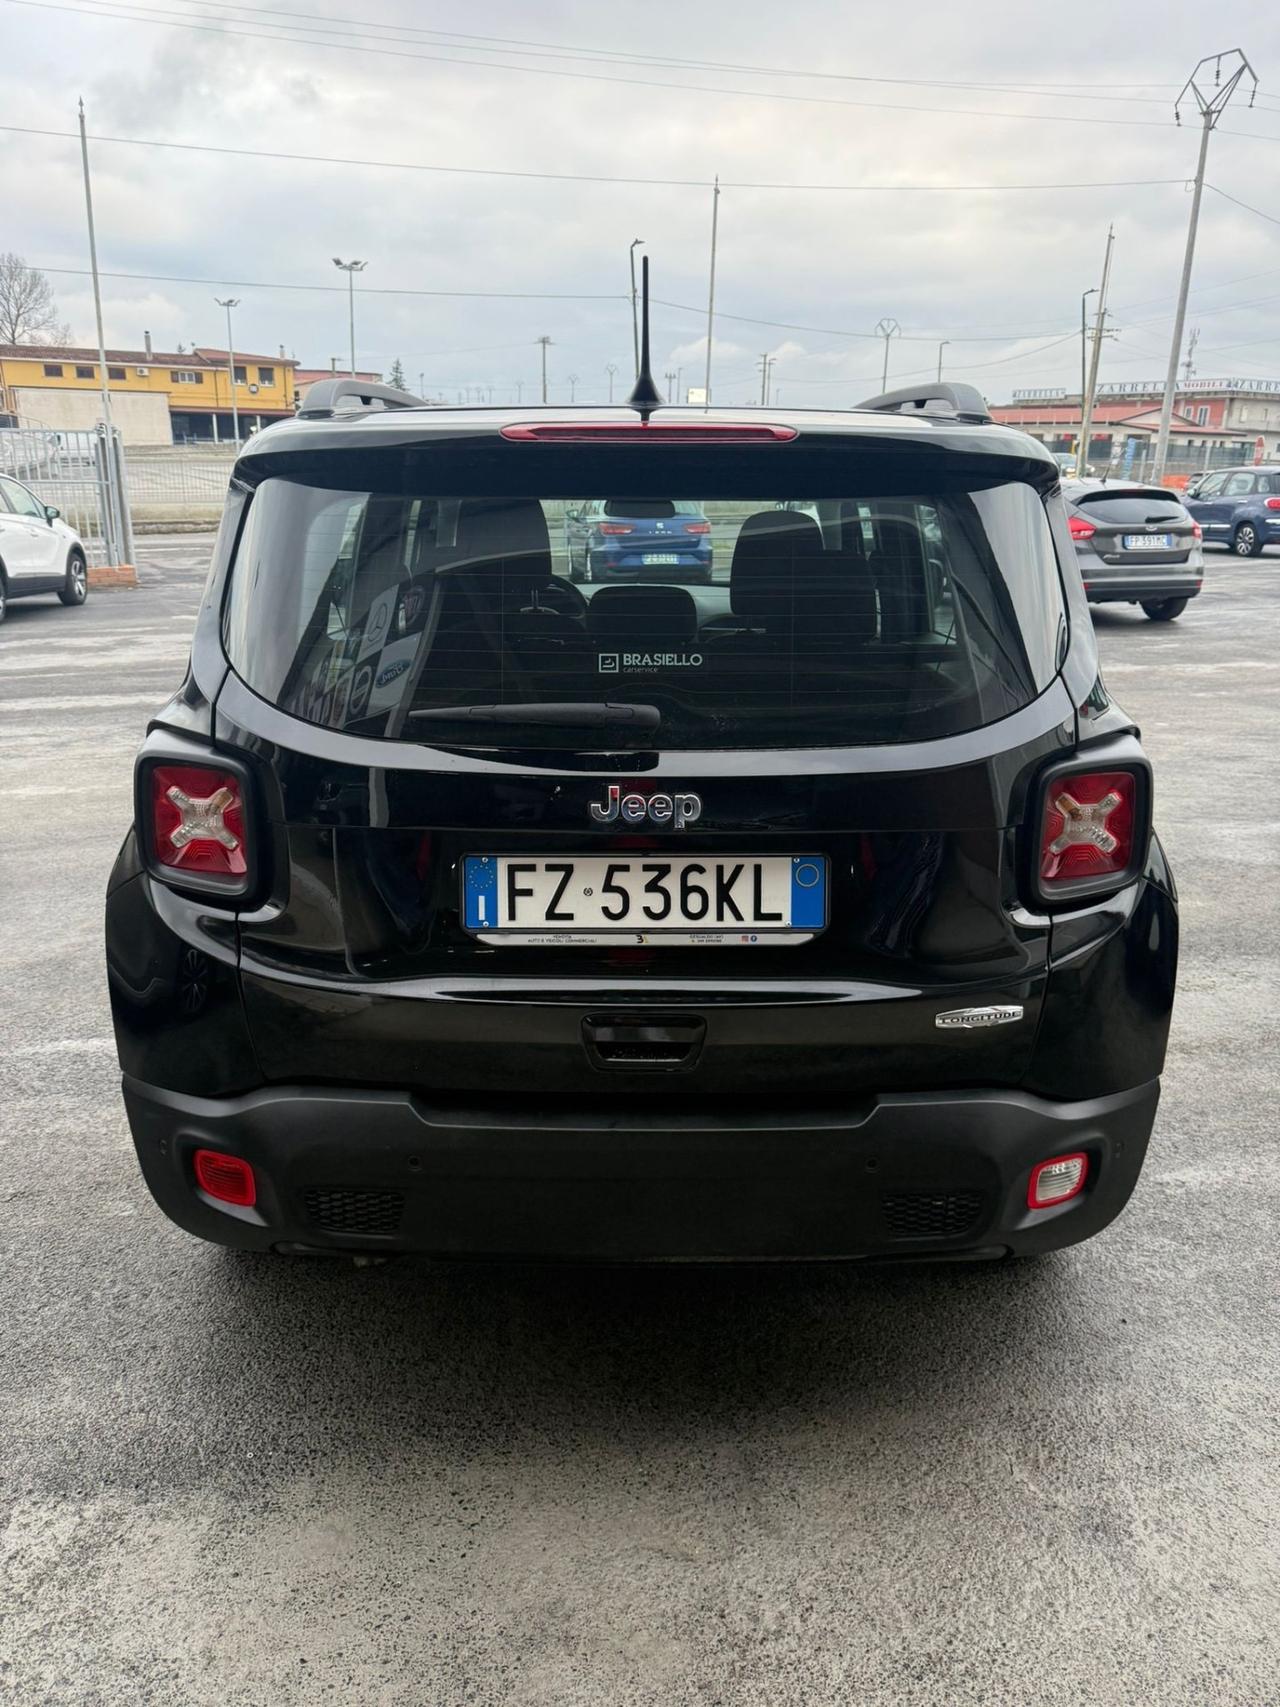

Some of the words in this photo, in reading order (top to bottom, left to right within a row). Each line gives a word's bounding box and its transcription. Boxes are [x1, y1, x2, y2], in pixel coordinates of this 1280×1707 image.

[623, 653, 703, 666] BRASIELLO
[590, 785, 702, 829] Jeep
[507, 863, 574, 921] FZ
[600, 863, 782, 921] 536KL
[941, 1011, 1018, 1024] LONGITUDE
